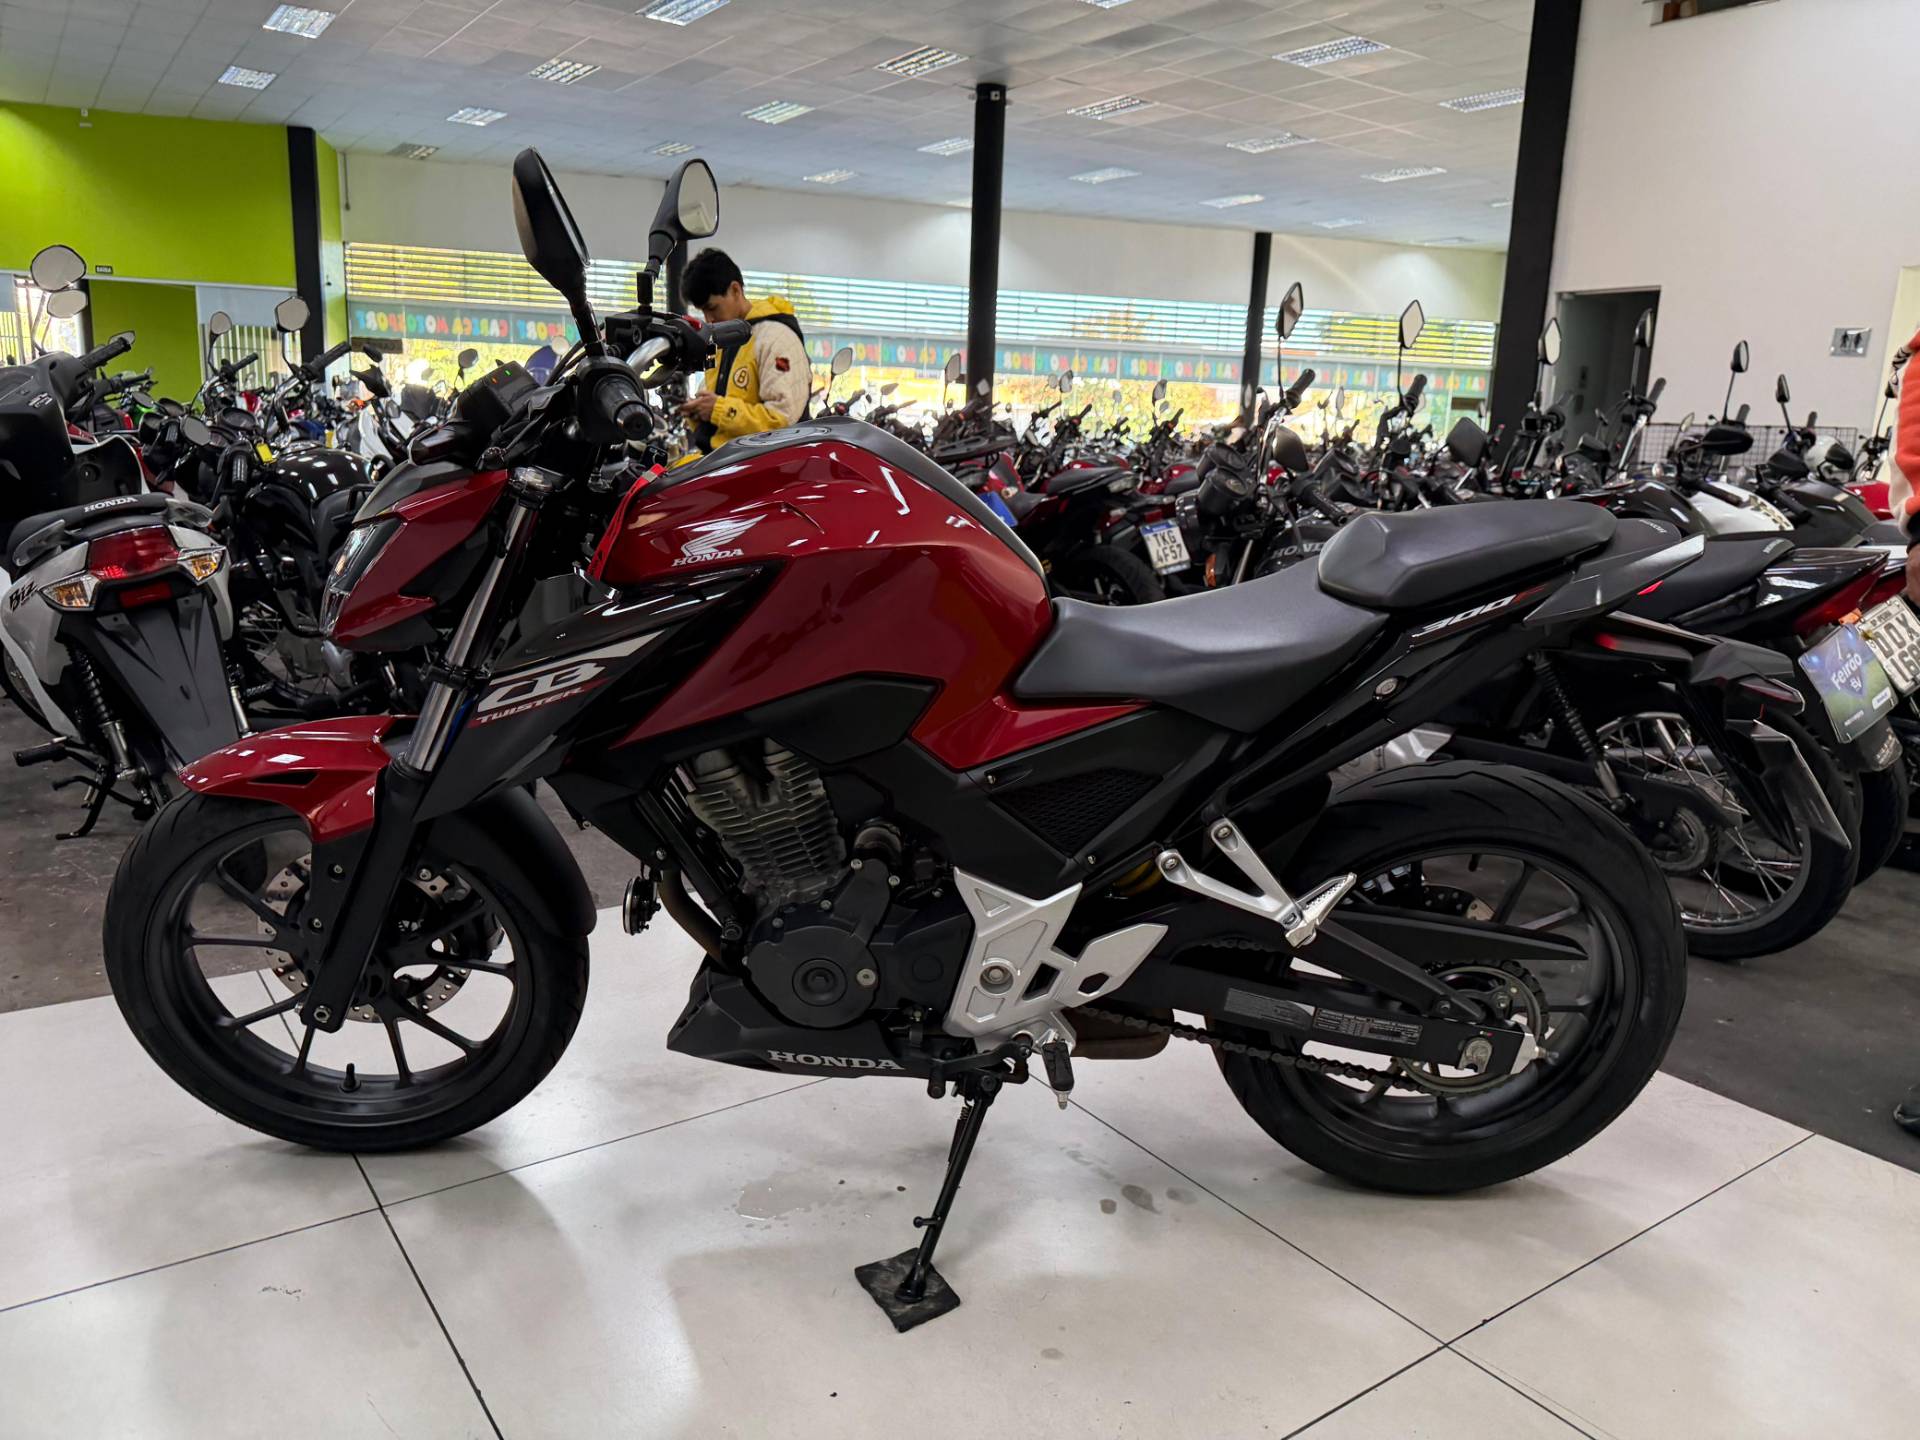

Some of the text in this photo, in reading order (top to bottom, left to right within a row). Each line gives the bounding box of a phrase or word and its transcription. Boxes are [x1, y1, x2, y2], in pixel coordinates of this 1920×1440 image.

[84, 496, 138, 513] HONDA
[1152, 529, 1177, 547] TKG
[671, 547, 745, 567] HONDA
[1156, 544, 1182, 563] 4F57
[9, 580, 38, 612] Biz
[477, 662, 607, 713] CB
[476, 687, 585, 723] TWISTER
[767, 1050, 905, 1070] HONDA
